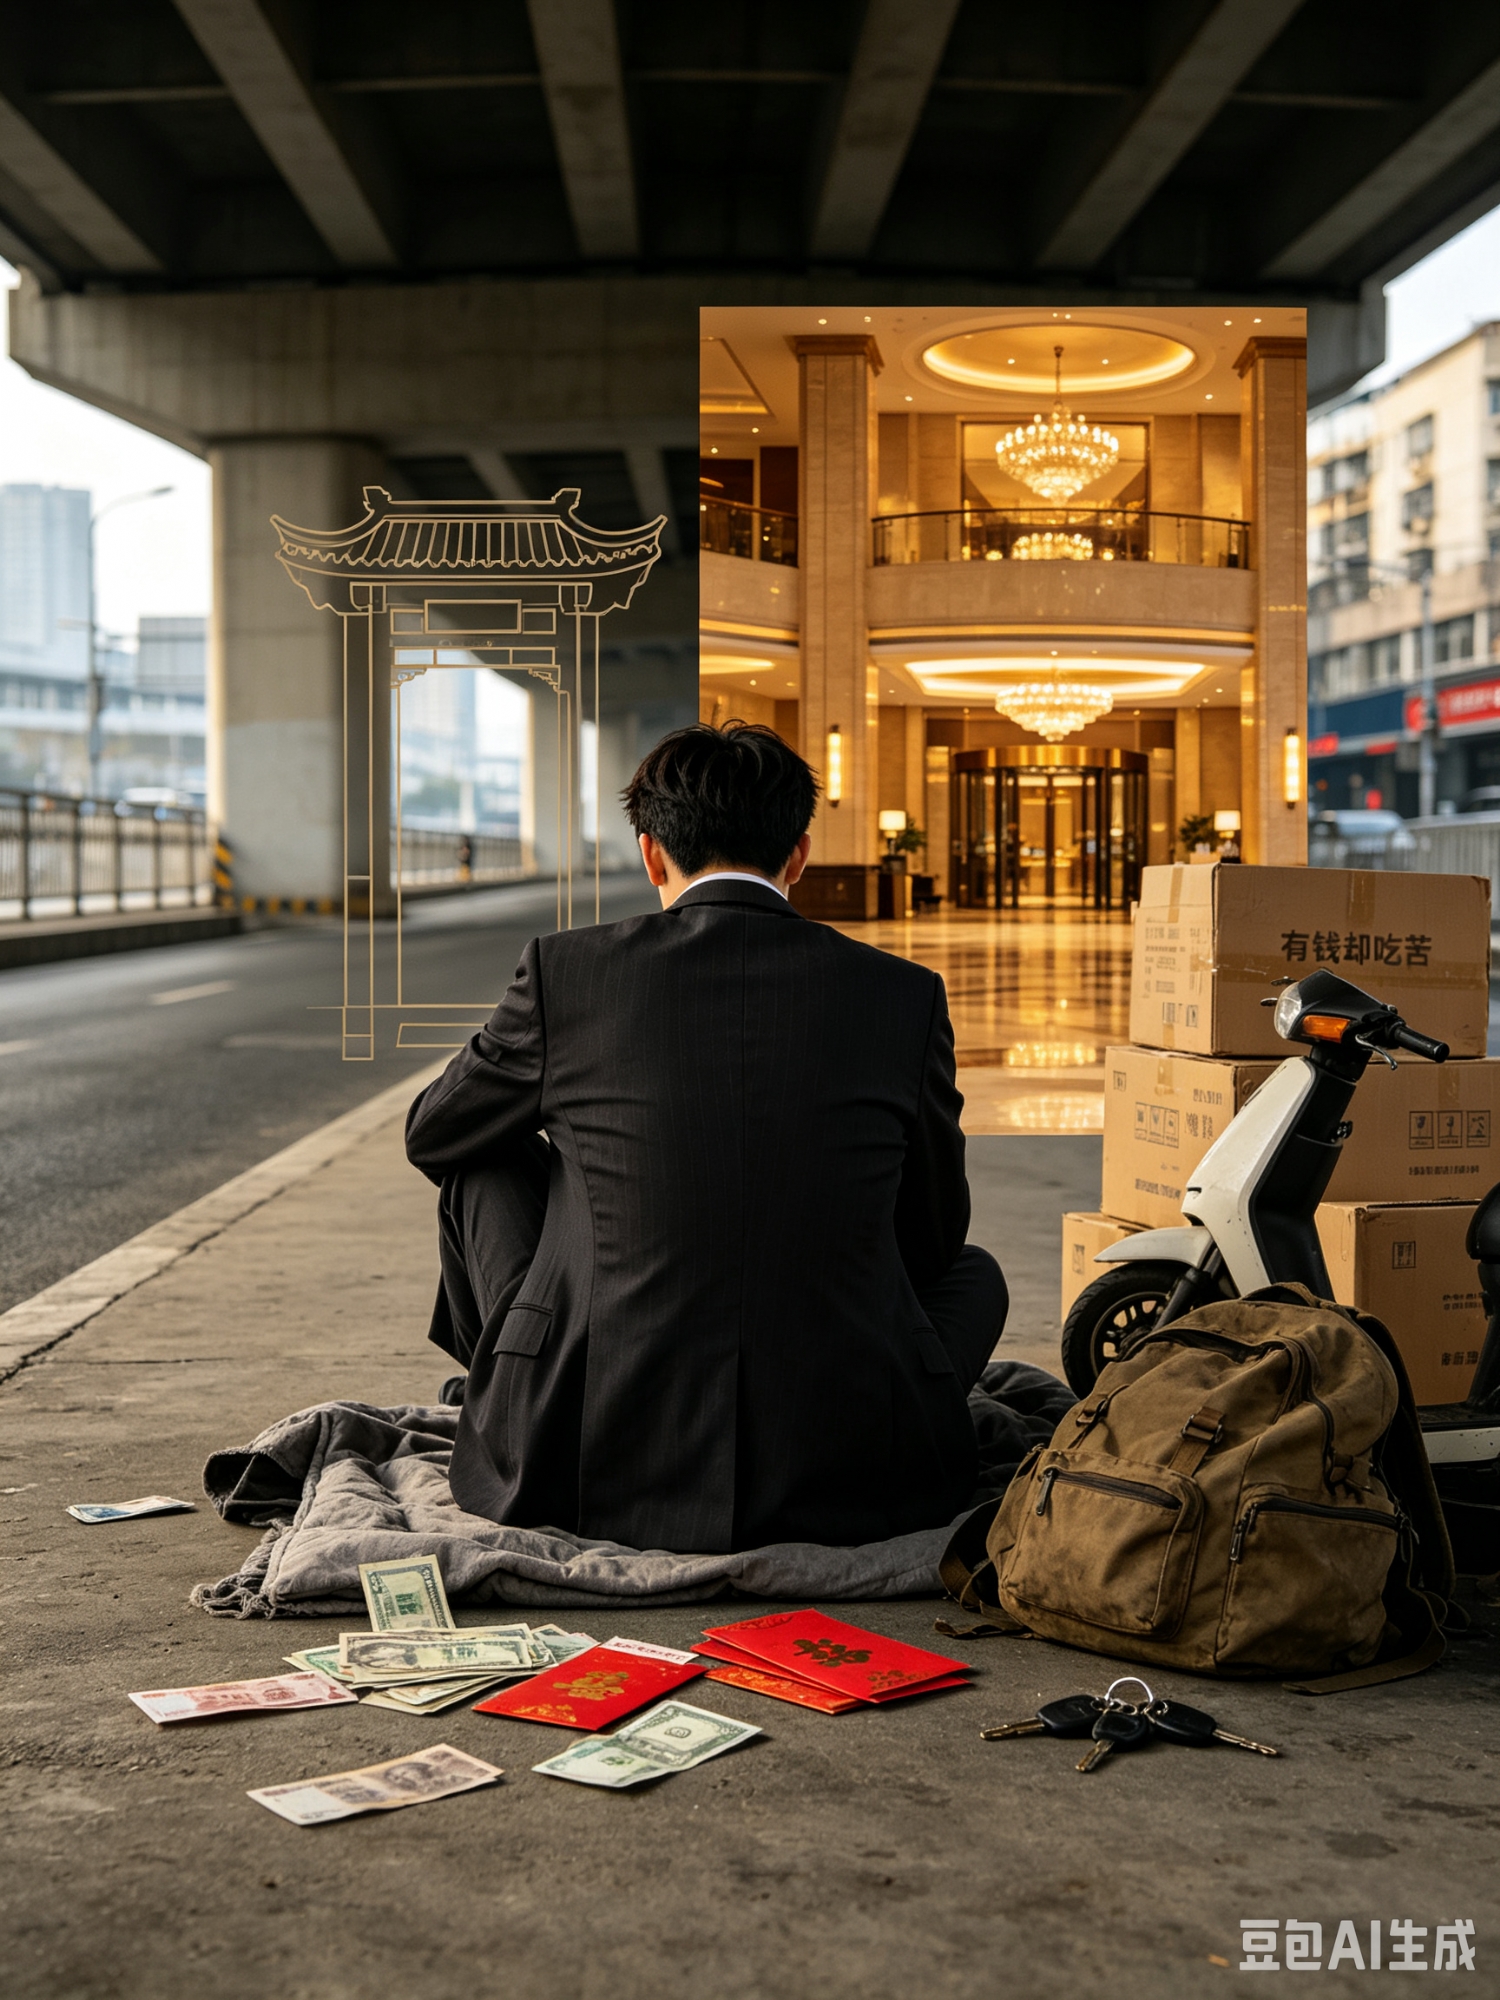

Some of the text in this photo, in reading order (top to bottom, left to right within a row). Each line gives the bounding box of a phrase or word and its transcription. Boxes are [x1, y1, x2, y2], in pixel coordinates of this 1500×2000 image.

[1281, 930, 1432, 966] 有钱却吃苦
